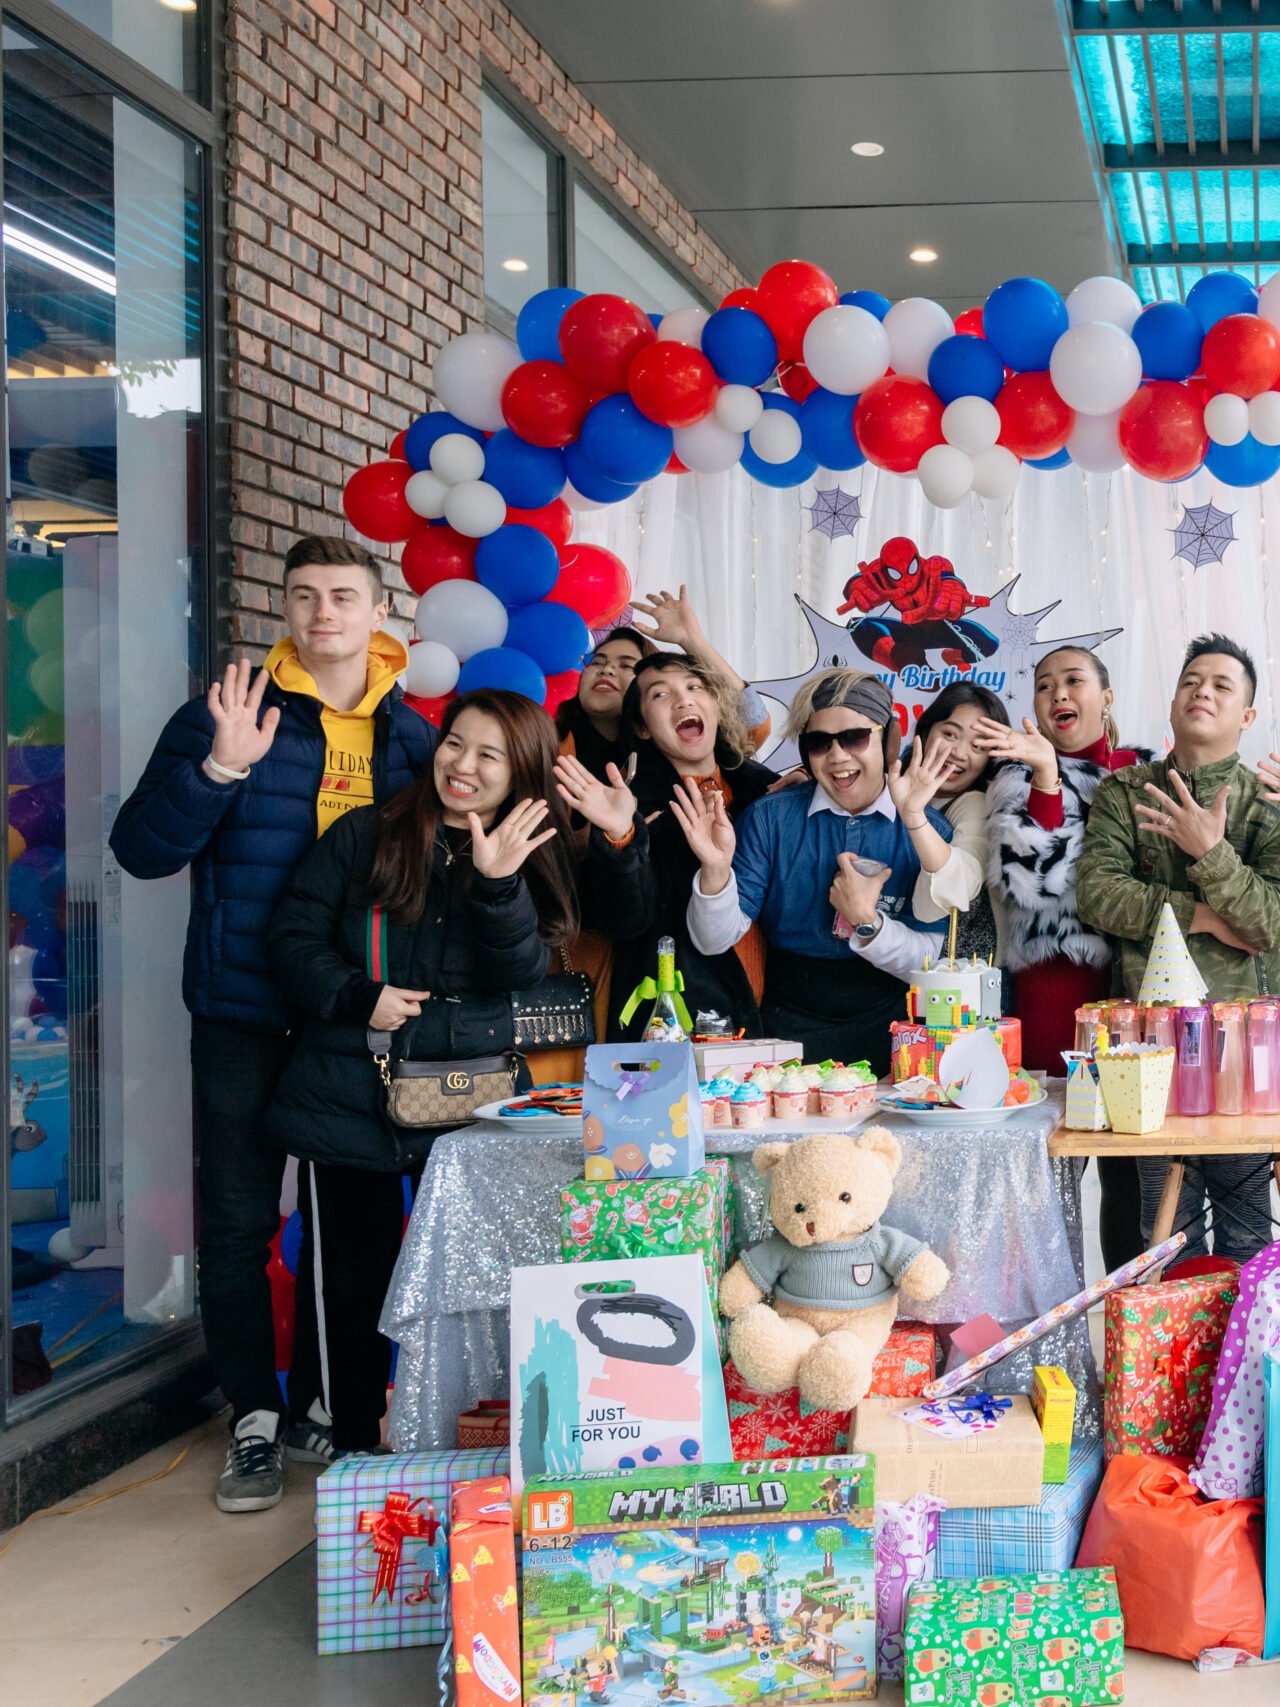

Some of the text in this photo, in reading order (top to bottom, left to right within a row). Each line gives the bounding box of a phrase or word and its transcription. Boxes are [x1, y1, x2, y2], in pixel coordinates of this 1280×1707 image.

[901, 665, 1006, 692] Birthday
[329, 750, 374, 775] LIDAY
[319, 799, 360, 810] ADIN
[586, 1407, 626, 1422] JUST
[572, 1425, 641, 1443] FOR YOU
[608, 1481, 788, 1522] MYWORLD
[529, 1535, 572, 1552] 6-12
